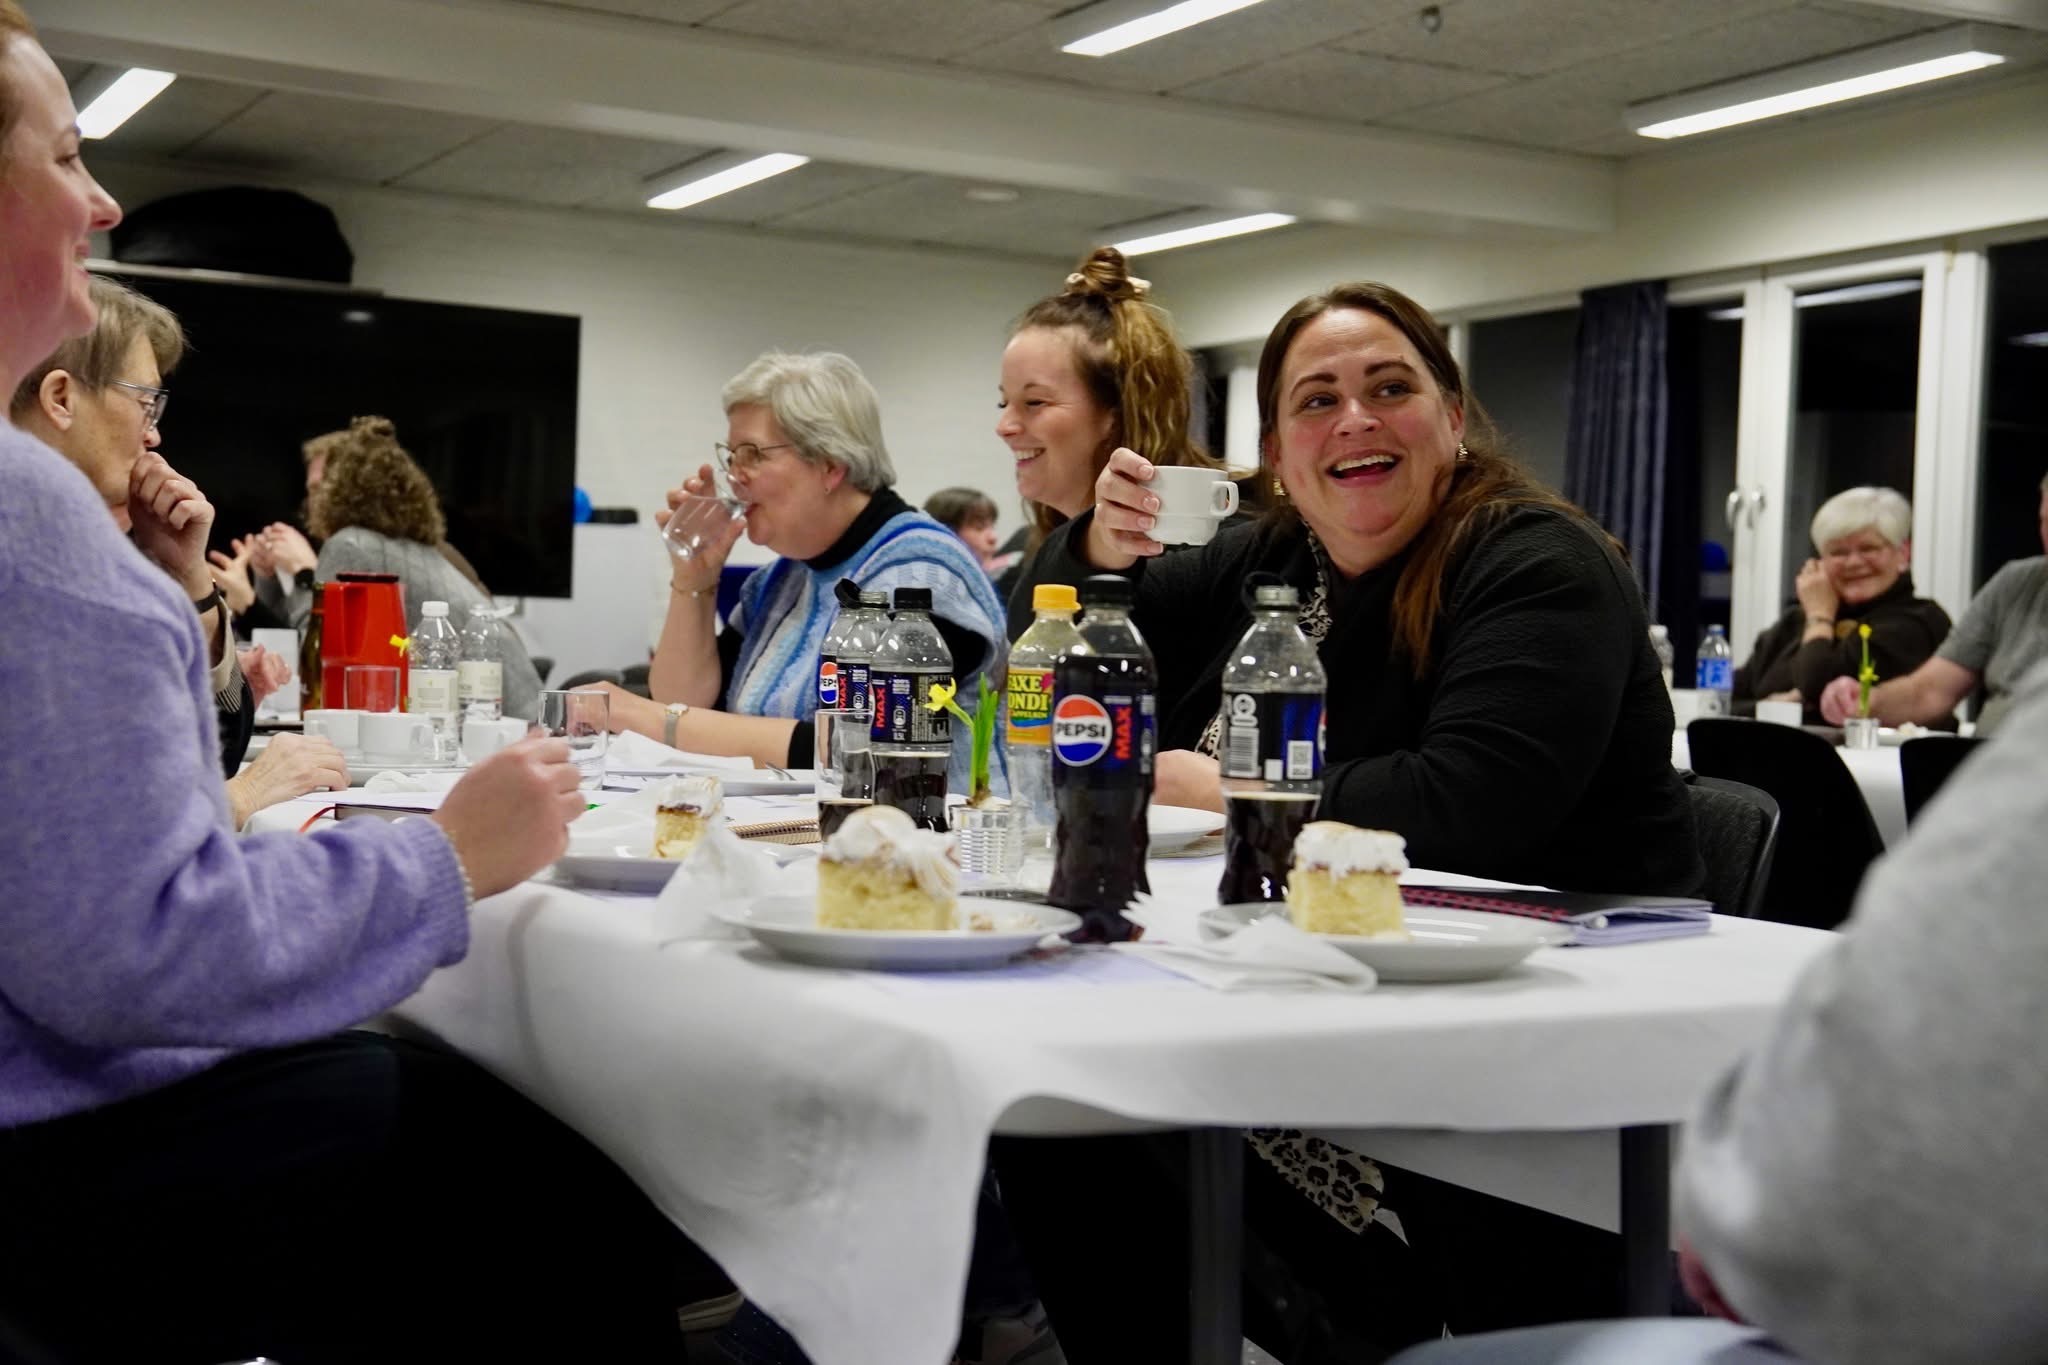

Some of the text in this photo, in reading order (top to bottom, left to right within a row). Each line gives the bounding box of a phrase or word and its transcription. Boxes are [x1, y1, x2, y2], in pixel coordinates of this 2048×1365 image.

[875, 687, 886, 728] MAX
[1008, 693, 1049, 711] ONDI
[1056, 722, 1106, 738] PEPSI
[1115, 706, 1132, 759] MAX
